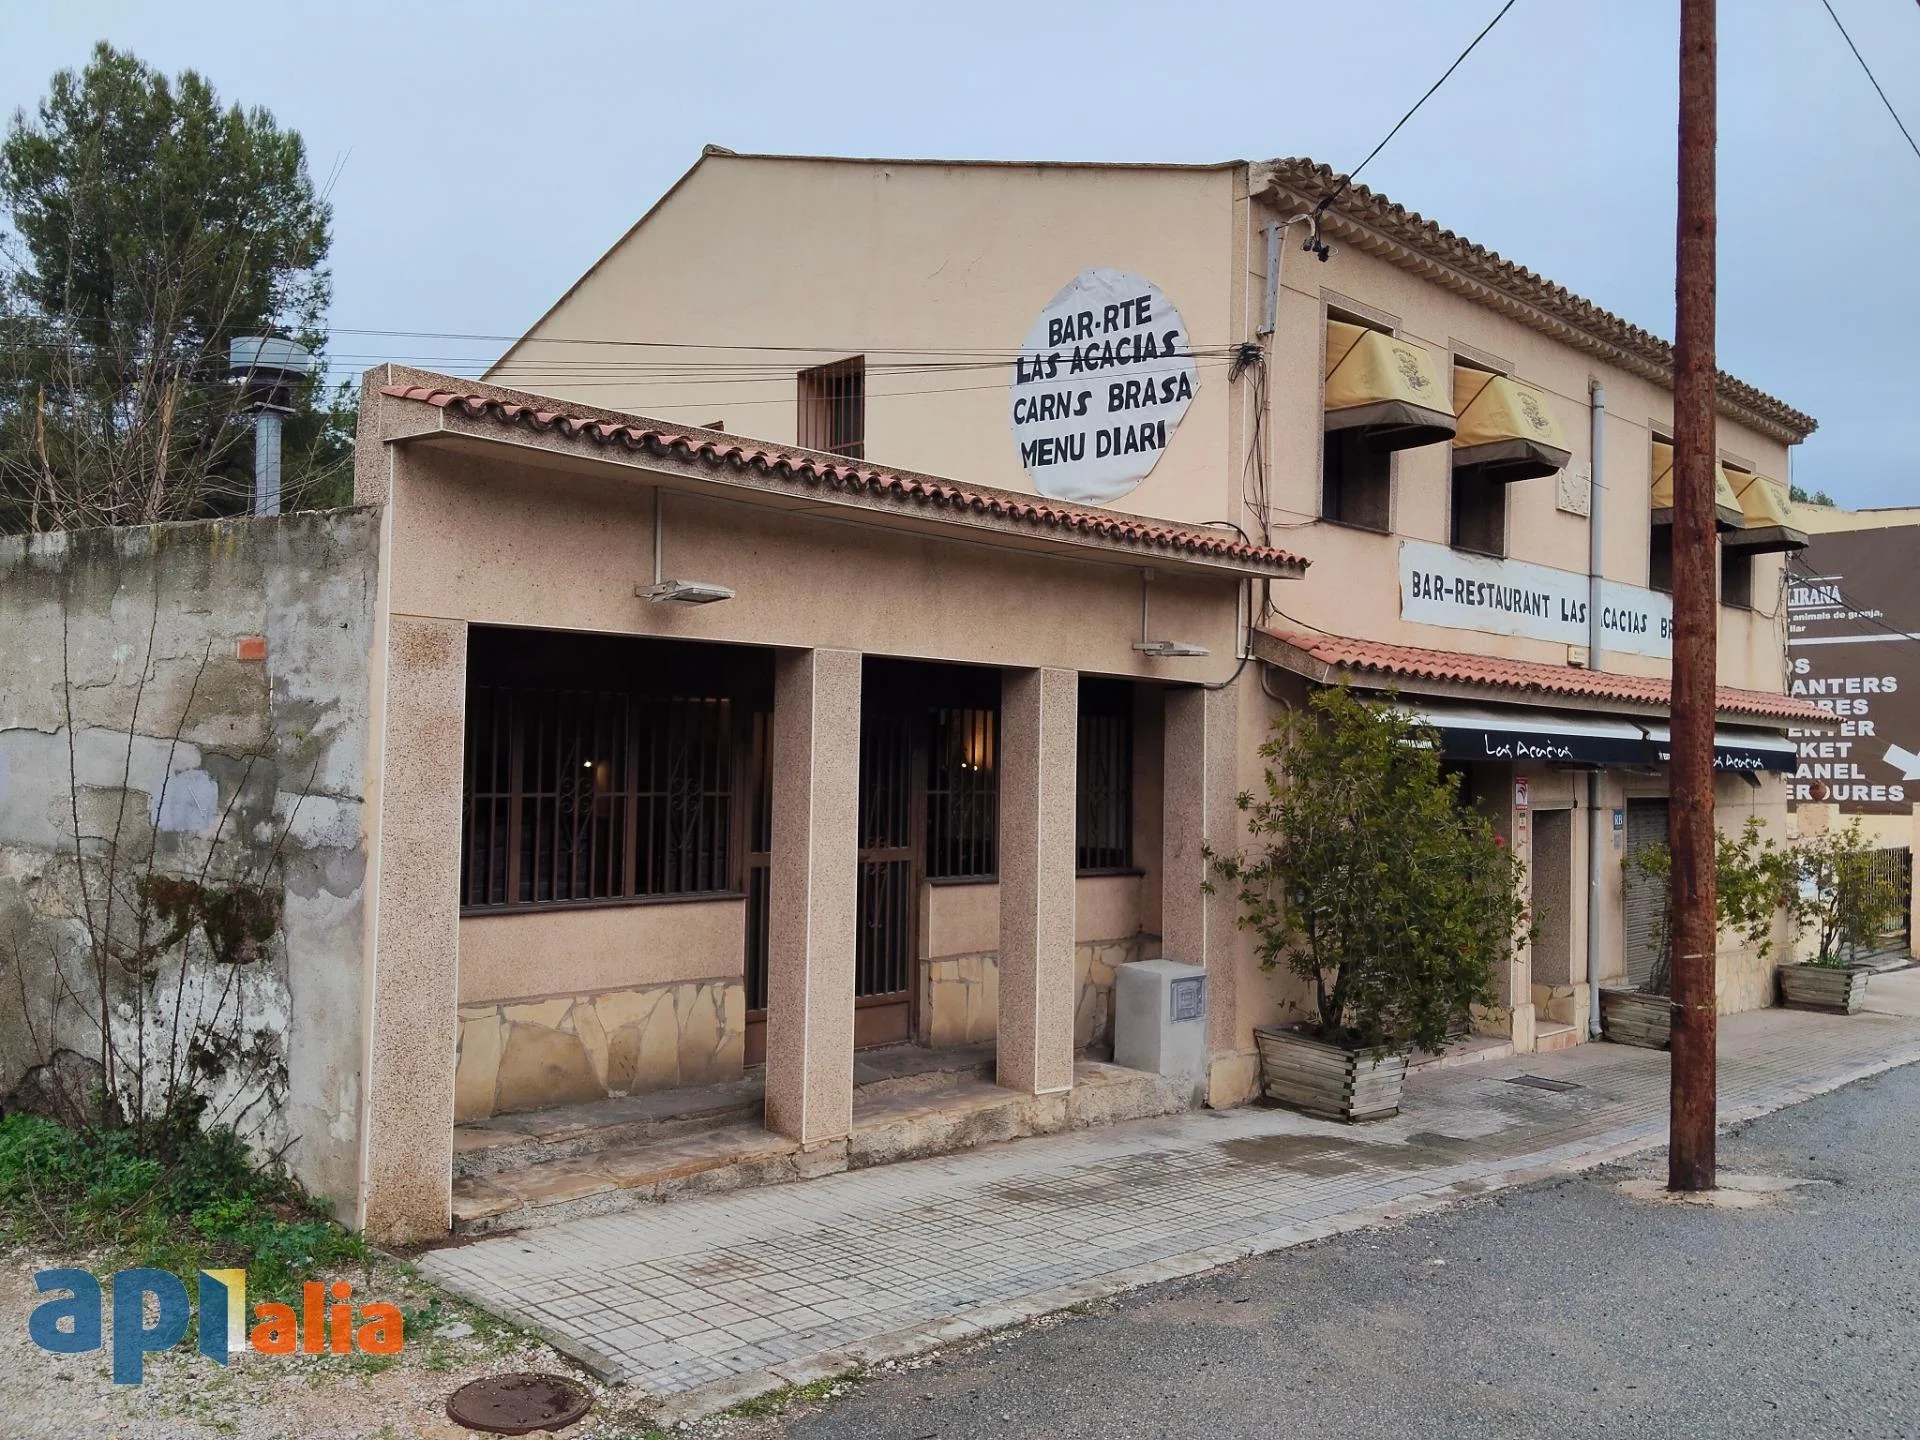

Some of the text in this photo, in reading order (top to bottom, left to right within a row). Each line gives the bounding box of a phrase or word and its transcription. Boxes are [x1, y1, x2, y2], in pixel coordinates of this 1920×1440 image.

[1049, 294, 1152, 348] BAR-RTE
[1016, 329, 1180, 385] LAS ACACIAS
[1013, 371, 1193, 425] CARNS BRASA
[1021, 420, 1166, 468] MENU DIARI
[1412, 570, 1551, 619] BAR-RESTAURANT
[1561, 598, 1587, 624] LAS
[1600, 606, 1647, 634] CACIAS
[1792, 611, 1831, 622] animals
[1833, 610, 1846, 619] de
[1484, 733, 1513, 759] Las
